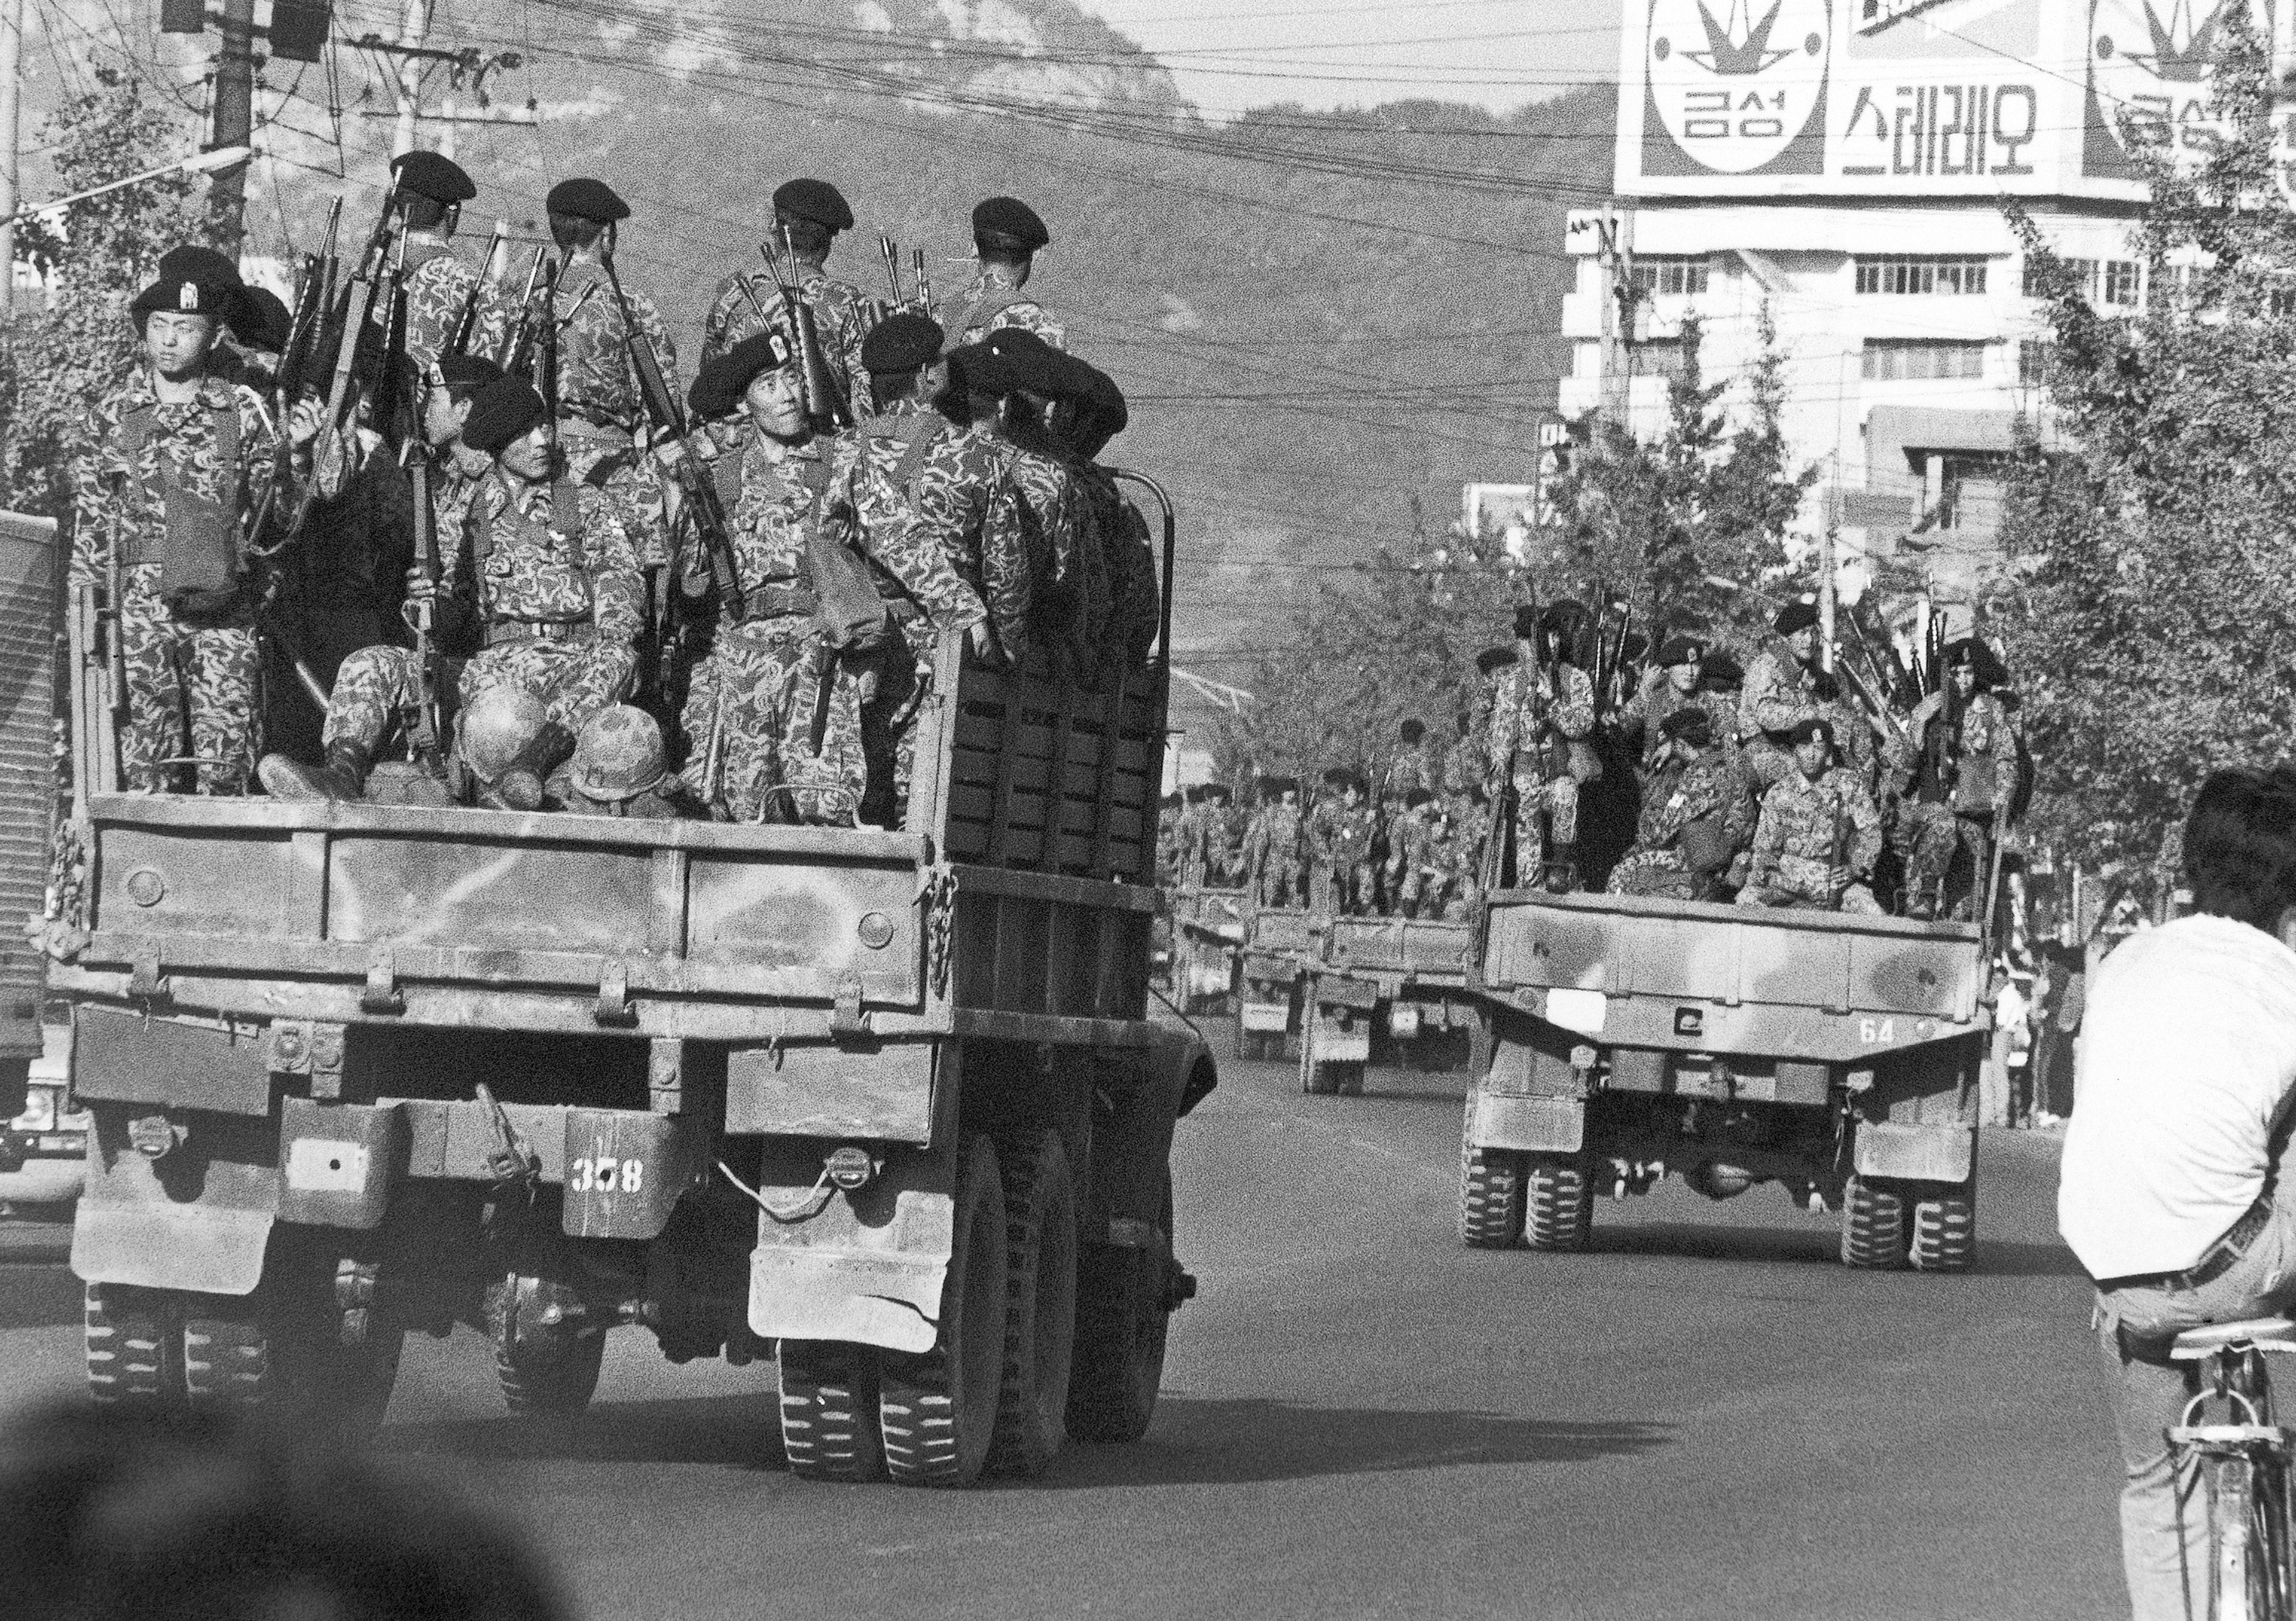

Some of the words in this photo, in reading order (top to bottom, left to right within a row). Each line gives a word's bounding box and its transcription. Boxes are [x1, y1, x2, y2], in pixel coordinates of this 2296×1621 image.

[1684, 90, 1785, 139] 금성
[1842, 85, 2037, 176] 스테레오
[1860, 1019, 1894, 1043] 64
[572, 1158, 643, 1193] 358
